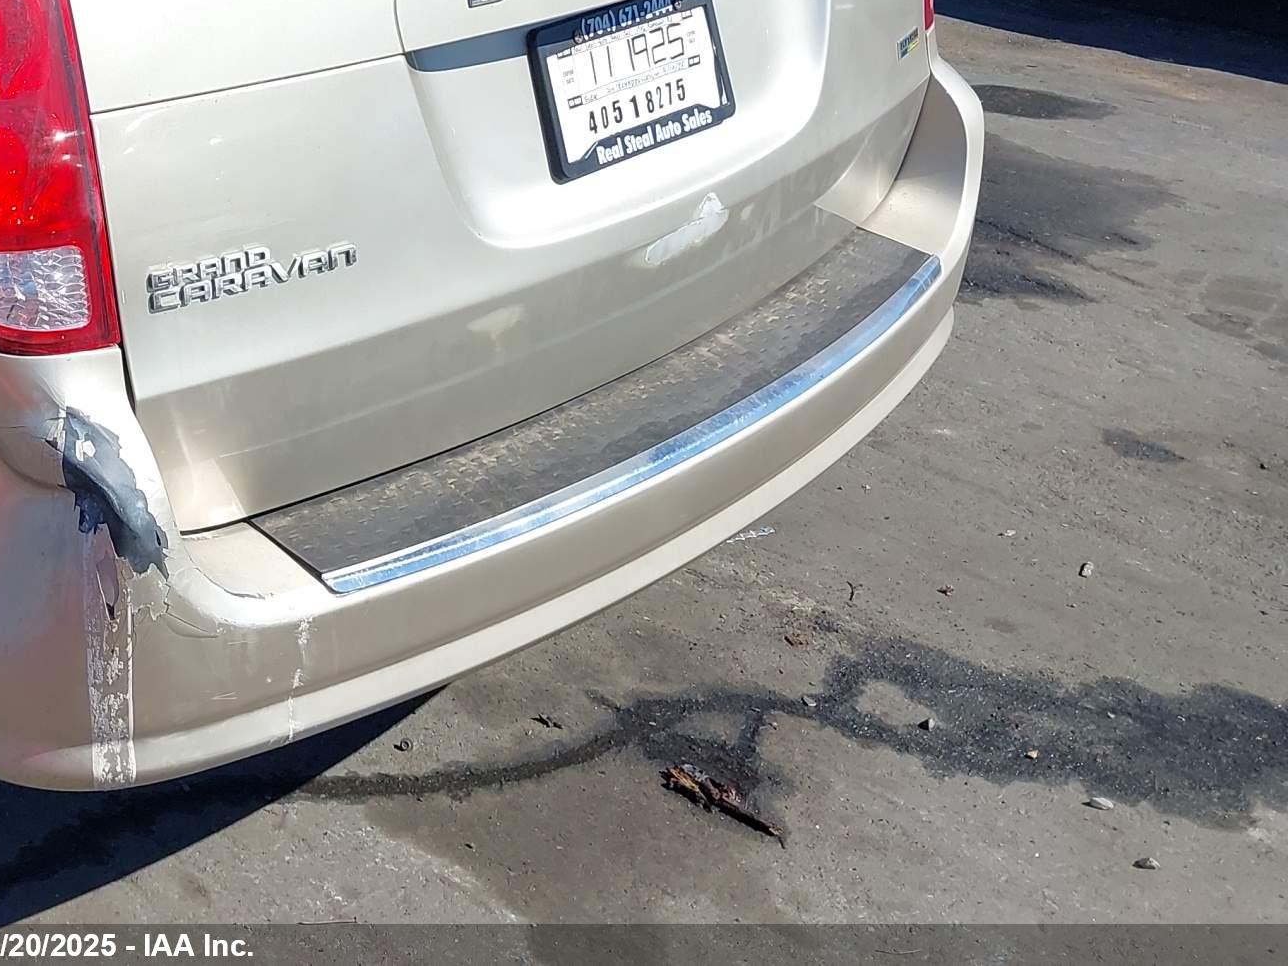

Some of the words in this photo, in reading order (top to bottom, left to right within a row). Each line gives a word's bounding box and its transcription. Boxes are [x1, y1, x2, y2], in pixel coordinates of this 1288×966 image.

[580, 12, 615, 39] (704)
[597, 137, 624, 165] Real
[626, 125, 654, 152] Steal
[655, 117, 681, 143] Auto
[682, 109, 713, 133] Sales
[147, 243, 270, 293] GRAND
[148, 242, 358, 314] CARAVAN
